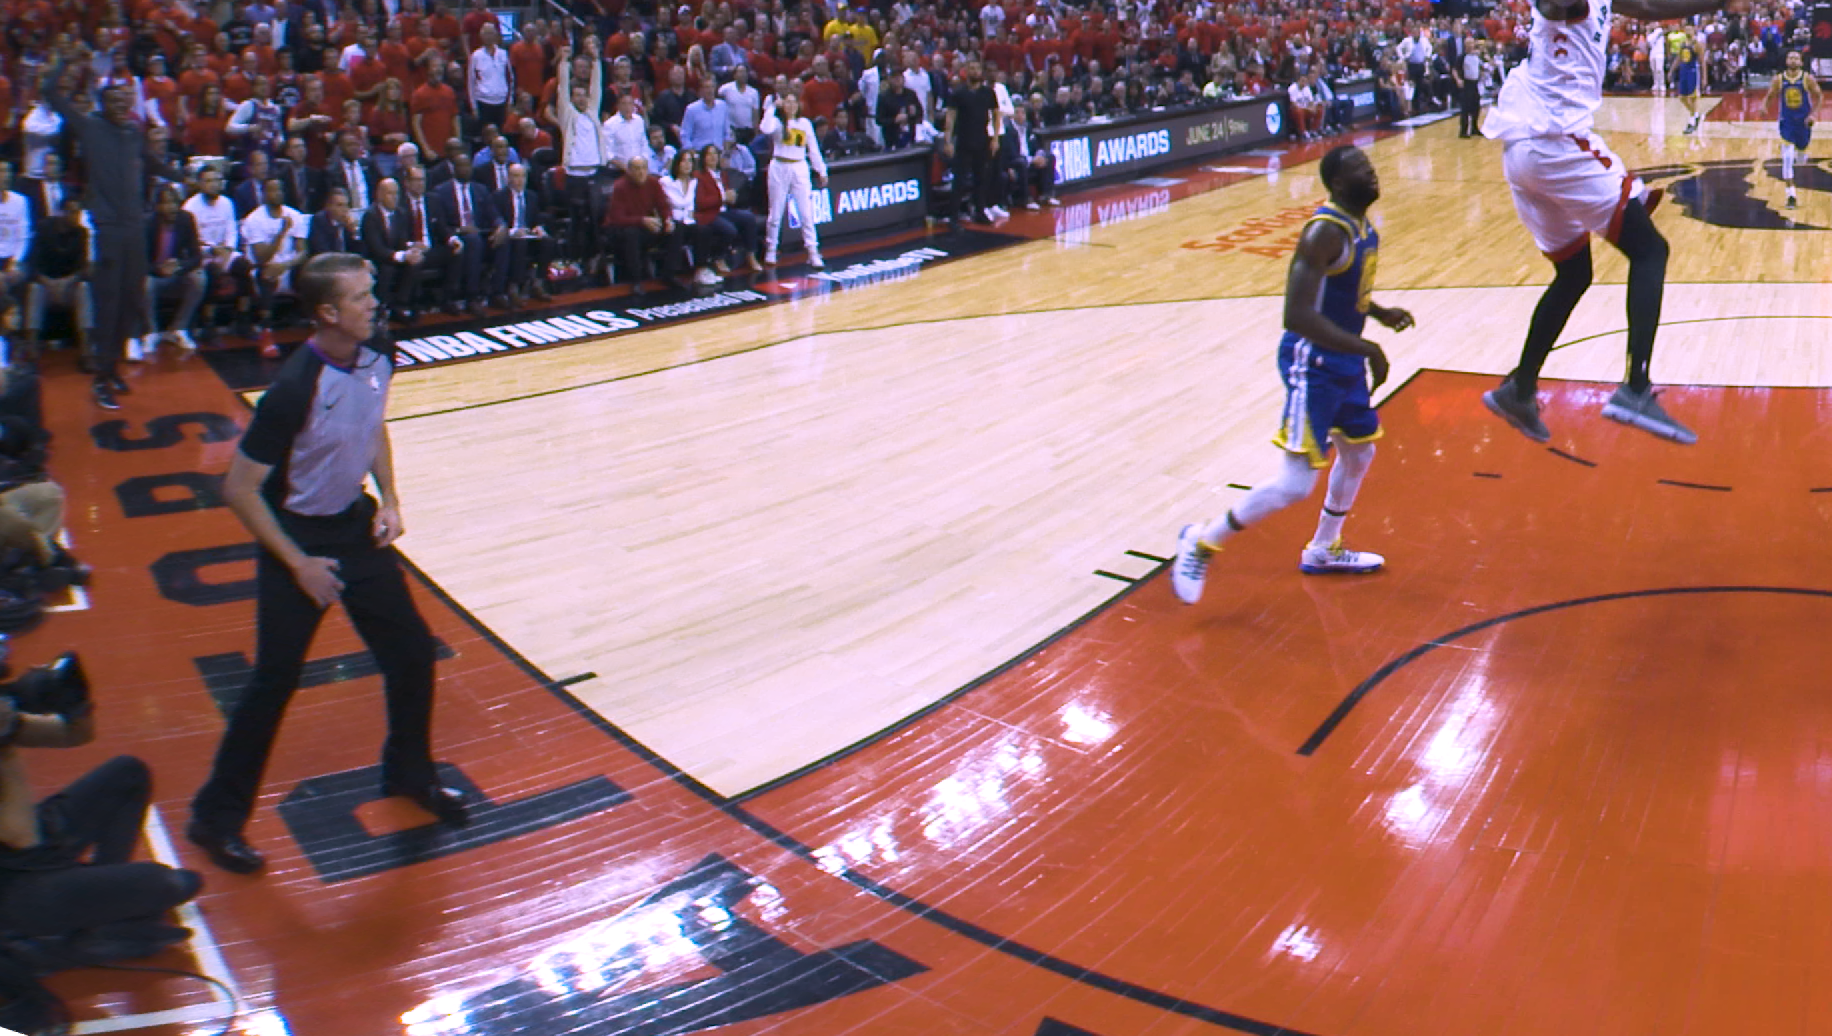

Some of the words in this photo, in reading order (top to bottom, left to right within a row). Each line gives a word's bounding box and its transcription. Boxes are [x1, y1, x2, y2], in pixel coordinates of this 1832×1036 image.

[1063, 136, 1092, 182] NBA
[1096, 130, 1171, 167] AWARDS
[808, 186, 832, 225] BA
[838, 179, 920, 215] AWARDS
[398, 330, 508, 365] NBA
[484, 309, 640, 350] FINALS
